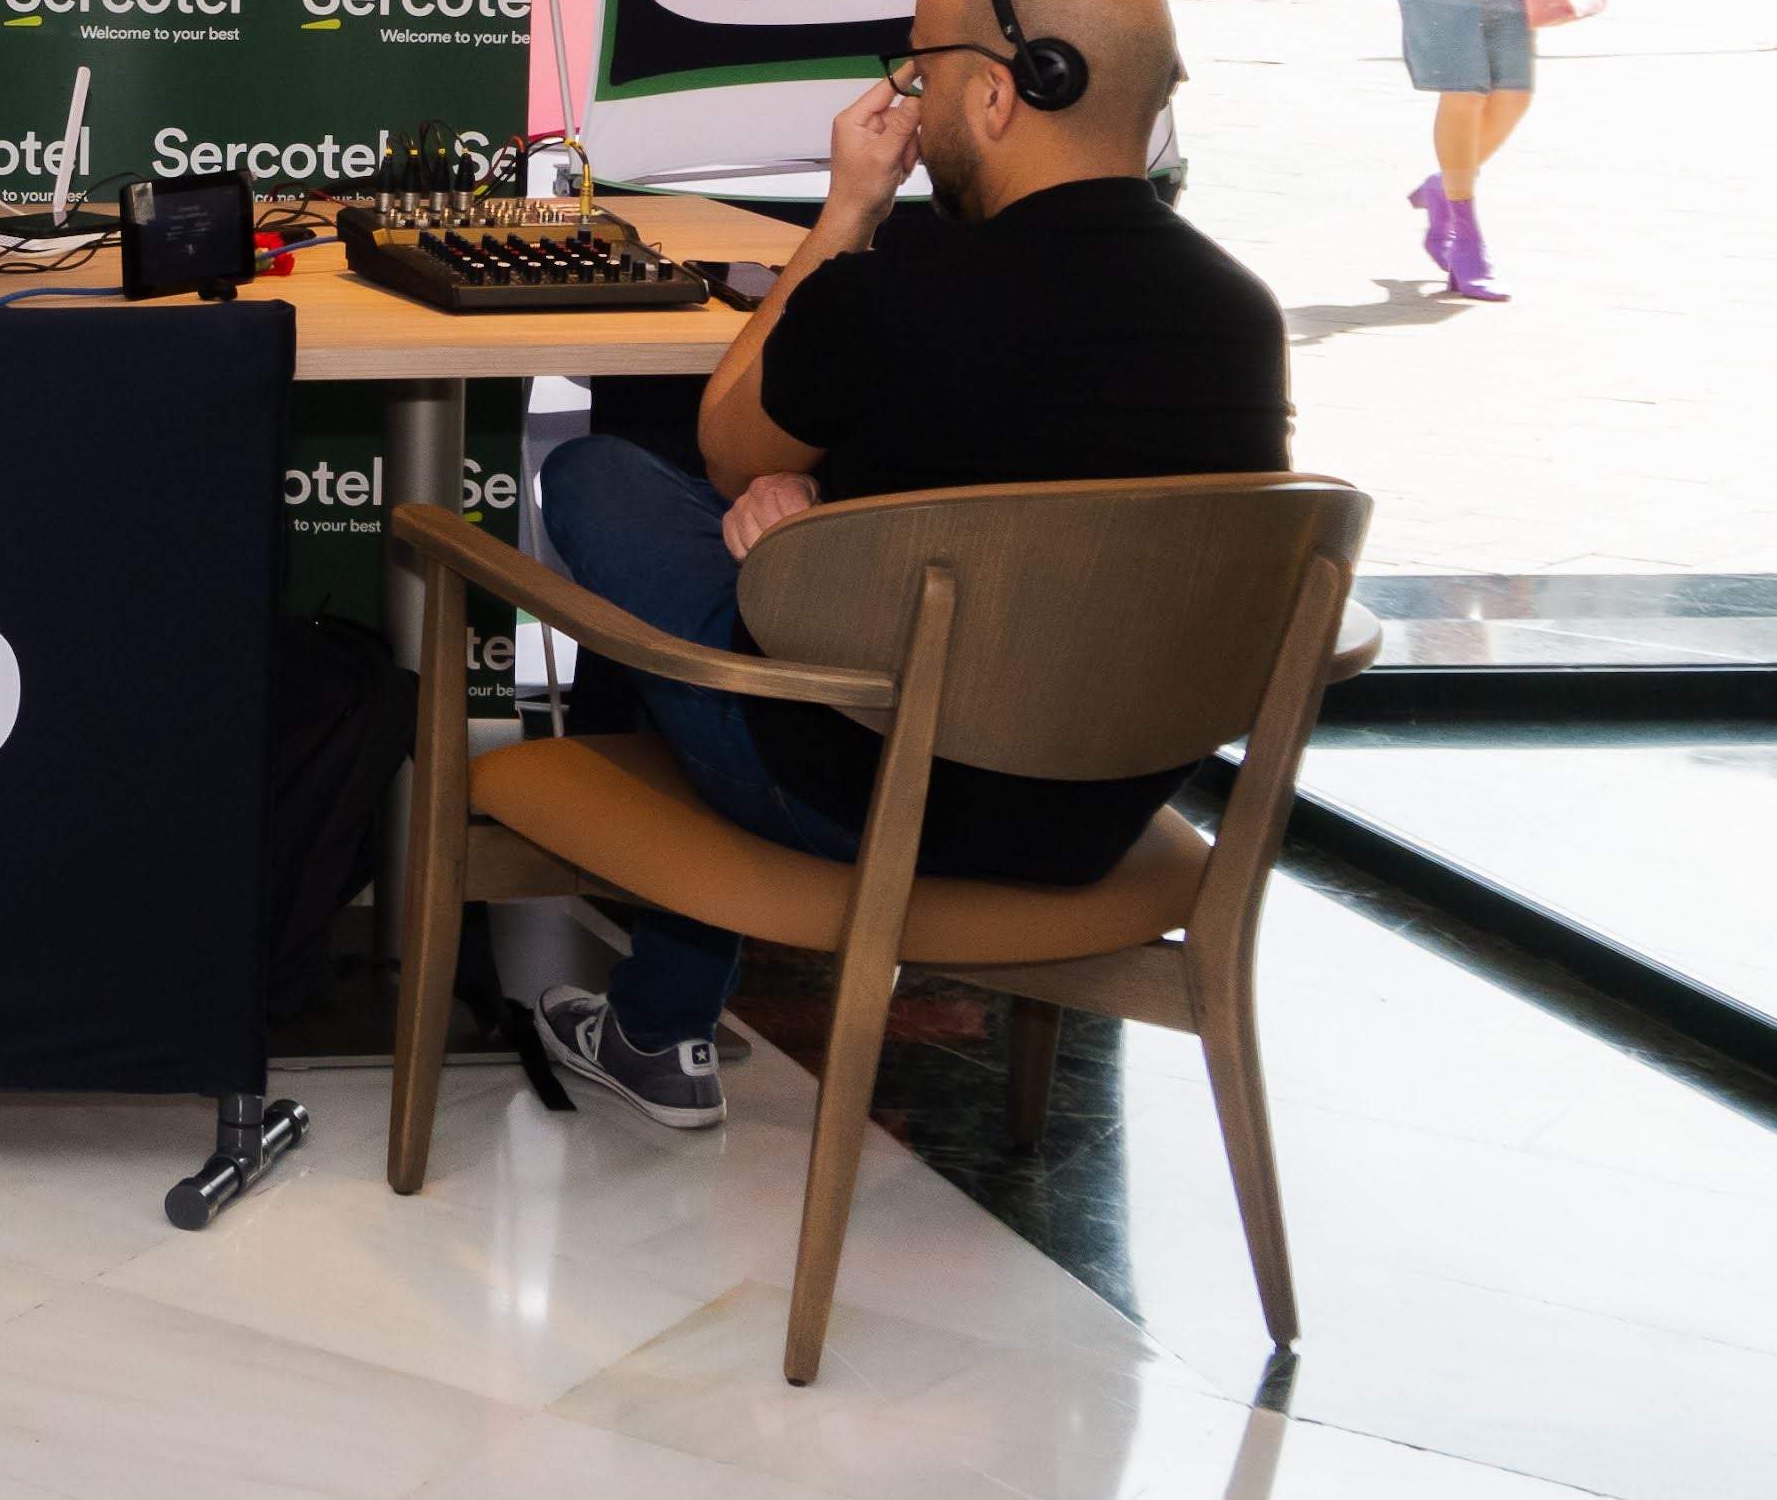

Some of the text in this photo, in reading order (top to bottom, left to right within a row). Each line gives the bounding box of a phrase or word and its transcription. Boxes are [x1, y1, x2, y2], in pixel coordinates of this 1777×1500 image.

[81, 26, 239, 43] Welcome to your best
[380, 29, 451, 43] Welcome
[455, 32, 470, 43] to
[474, 34, 508, 46] your
[294, 518, 382, 534] to your best
